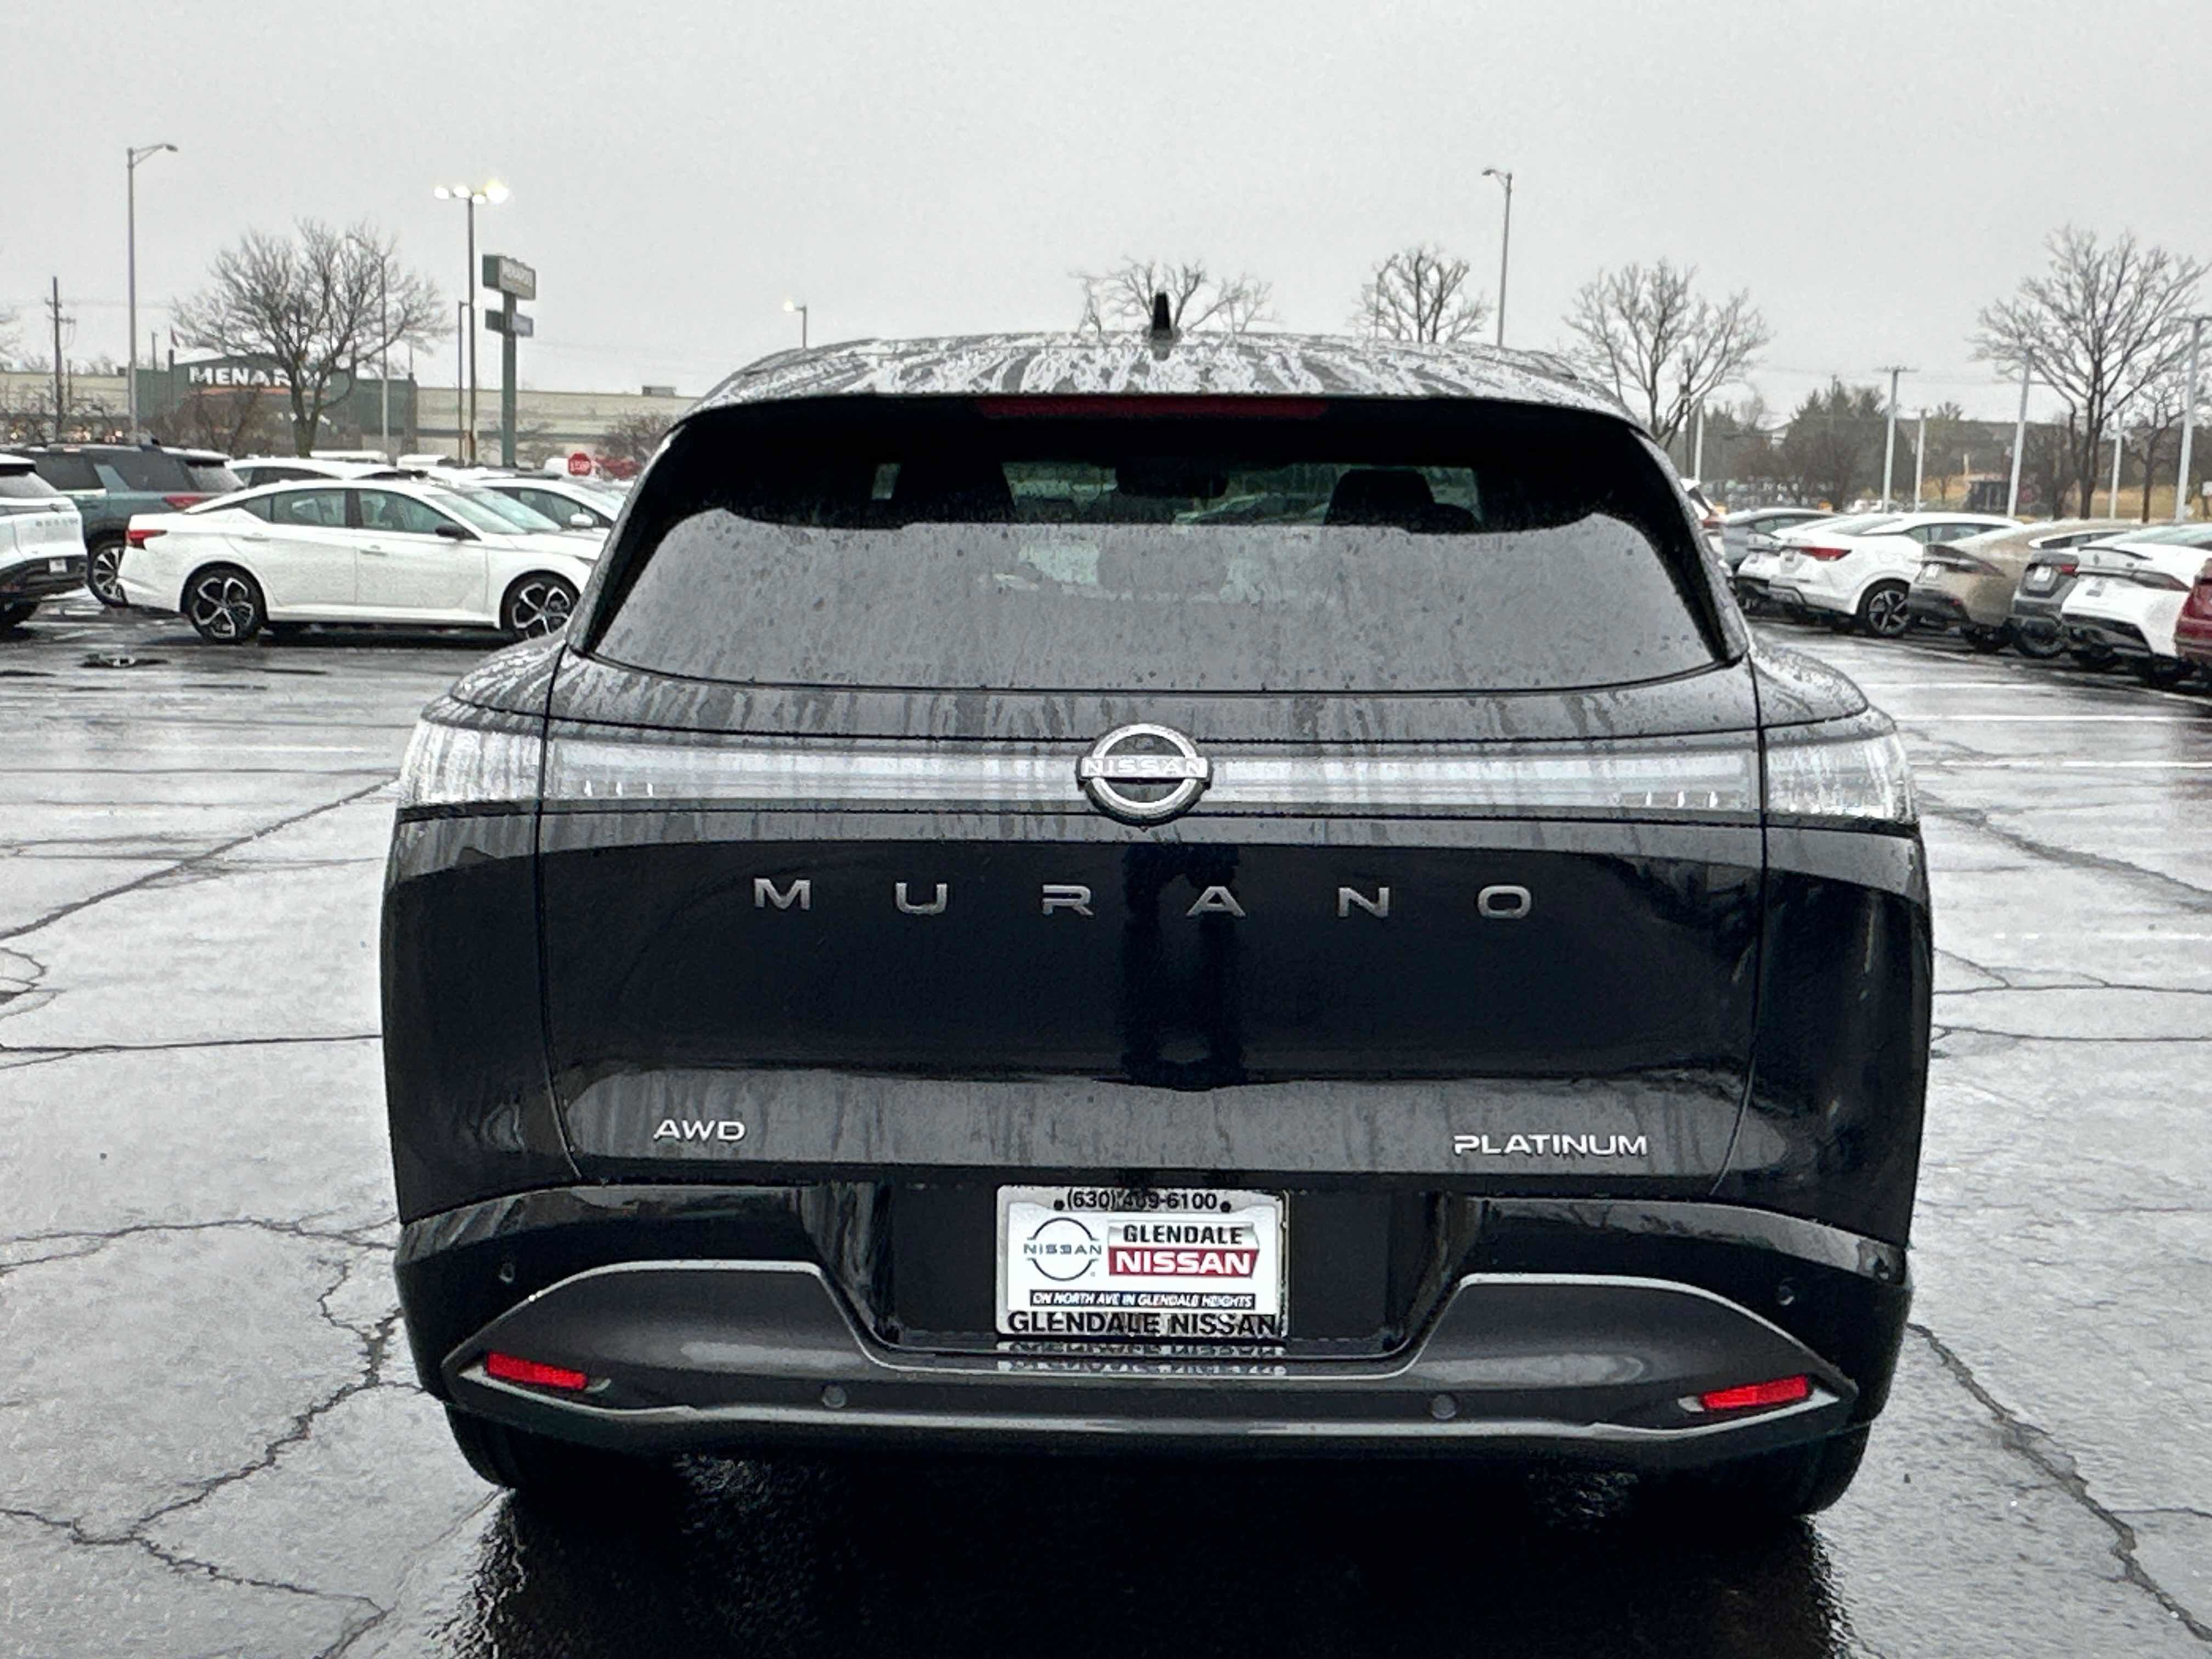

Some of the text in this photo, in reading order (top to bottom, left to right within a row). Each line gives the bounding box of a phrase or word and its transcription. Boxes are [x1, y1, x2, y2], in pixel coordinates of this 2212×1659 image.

[1084, 758, 1202, 775] NISSAN
[754, 878, 1532, 918] MURANO
[653, 1119, 746, 1141] AWD
[1453, 1133, 1647, 1156] PLATINUM
[1124, 1224, 1243, 1244] GLENDALE
[1023, 1243, 1102, 1255] NISSAN
[1116, 1251, 1250, 1274] NISSAN
[1032, 1292, 1053, 1304] ON
[1053, 1292, 1095, 1305] NORTH
[1096, 1293, 1120, 1305] AVE
[1121, 1294, 1136, 1306] IN
[1137, 1294, 1199, 1307] GLENDALE
[1008, 1311, 1277, 1336] GLENDALE NISSAN
